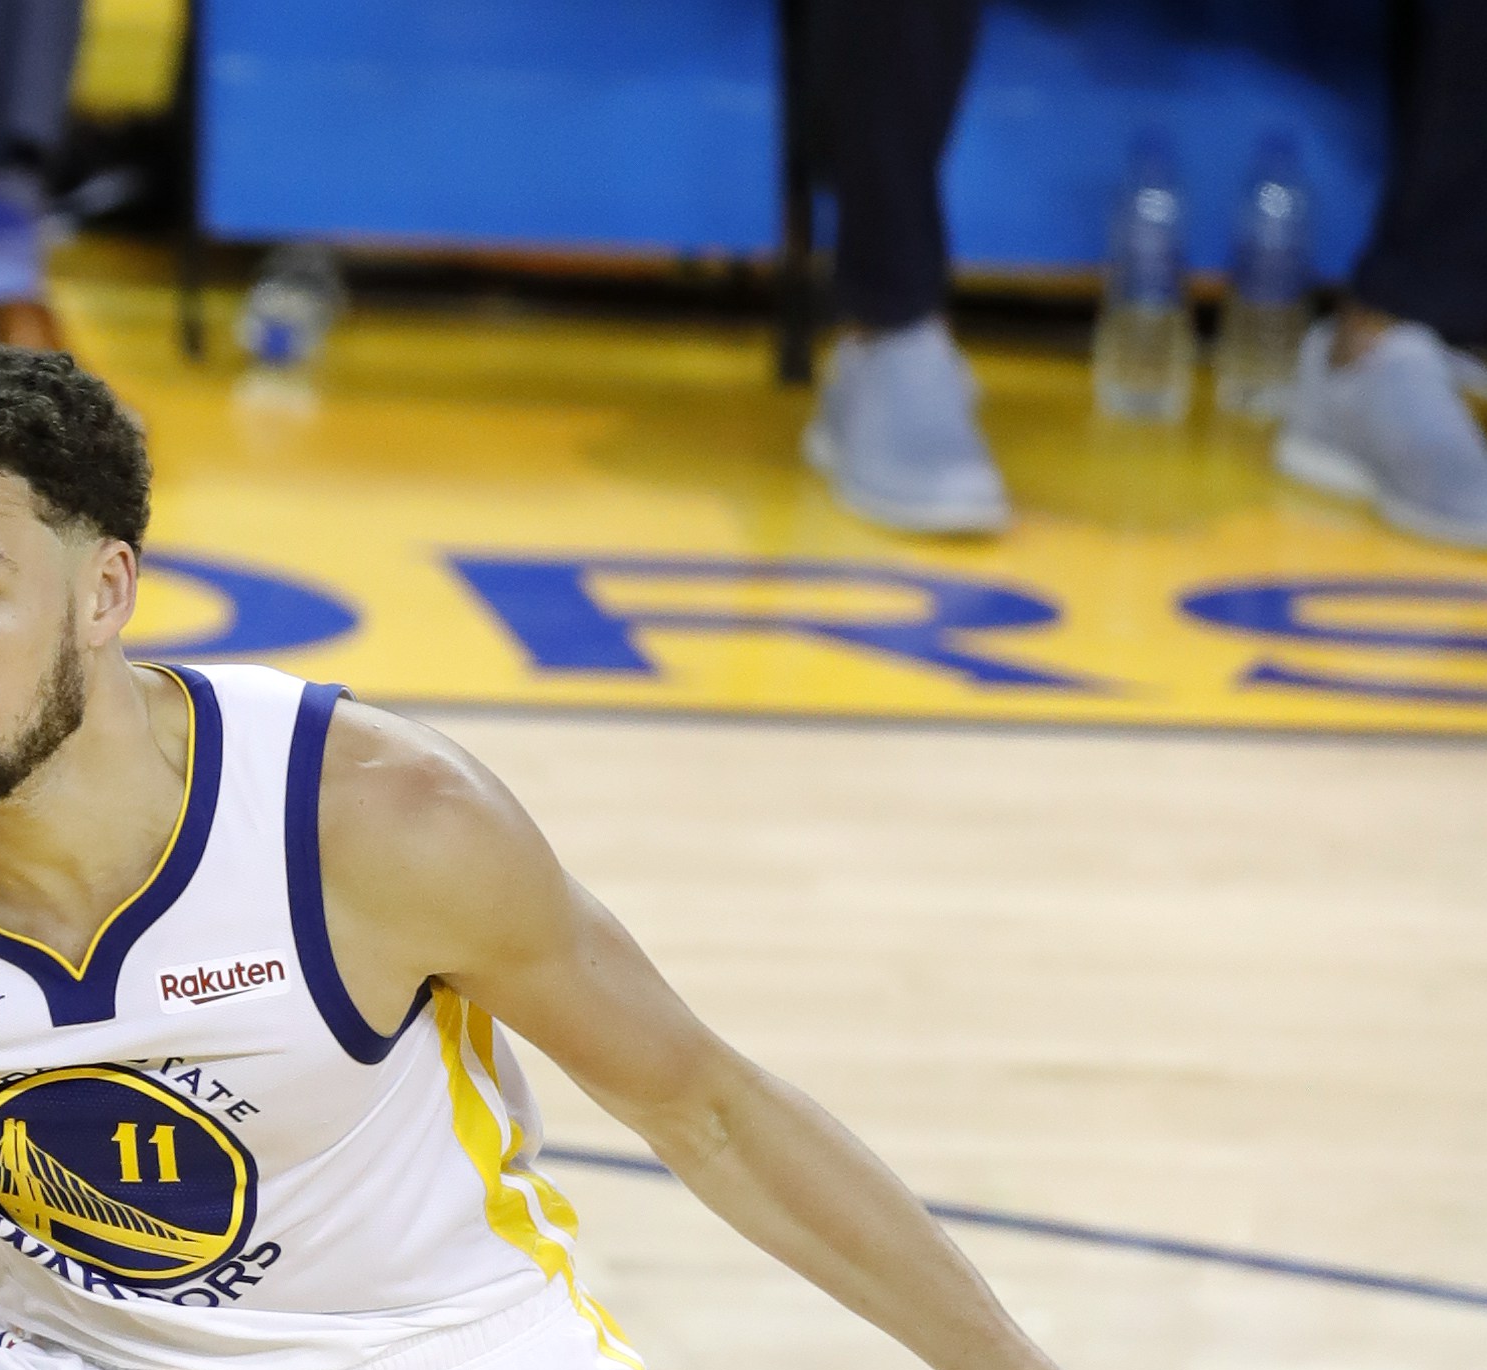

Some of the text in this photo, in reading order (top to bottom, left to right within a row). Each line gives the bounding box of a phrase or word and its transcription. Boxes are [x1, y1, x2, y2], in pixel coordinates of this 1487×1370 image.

[160, 959, 286, 1002] Rakuten
[127, 1056, 260, 1123] TATE
[111, 1122, 181, 1183] 11
